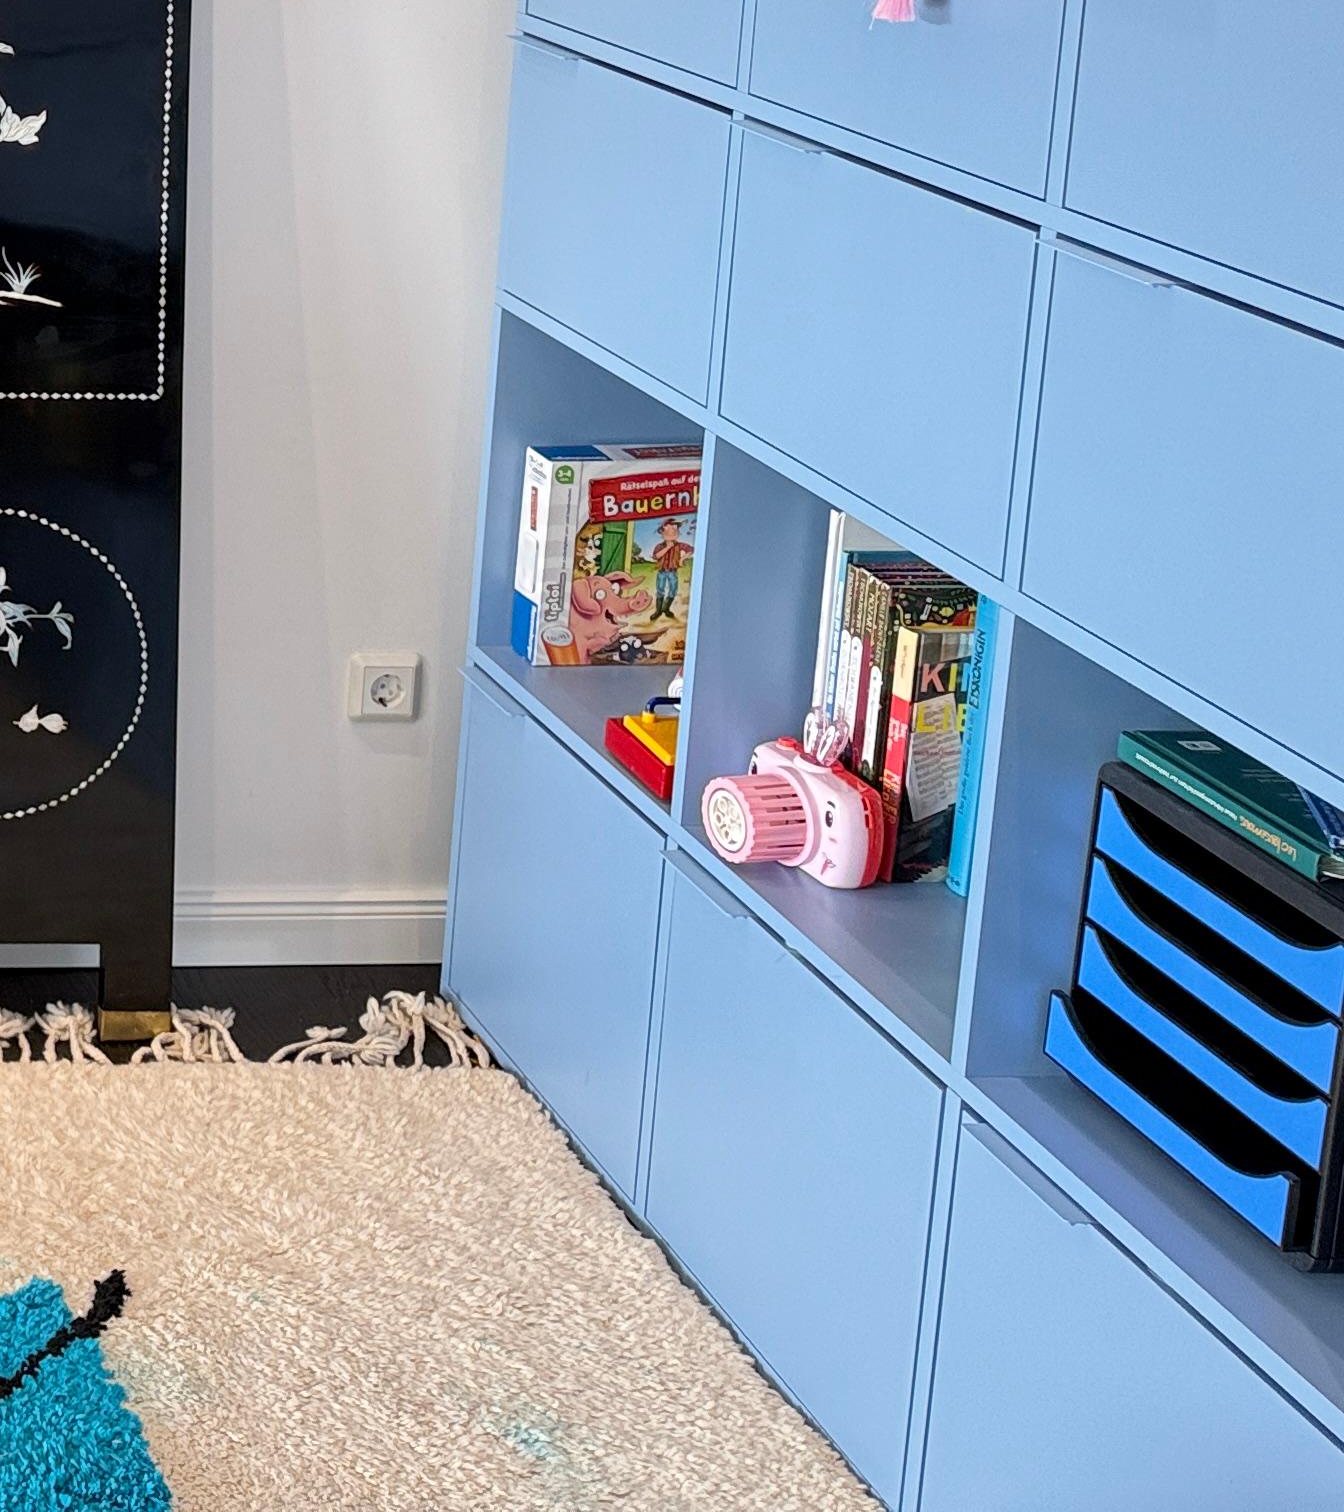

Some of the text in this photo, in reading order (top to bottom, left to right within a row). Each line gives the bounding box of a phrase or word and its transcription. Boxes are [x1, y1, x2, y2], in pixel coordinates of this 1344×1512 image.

[620, 474, 699, 491] Rätselspaß auf de
[544, 583, 561, 623] tiptoi
[866, 591, 876, 634] MOZART
